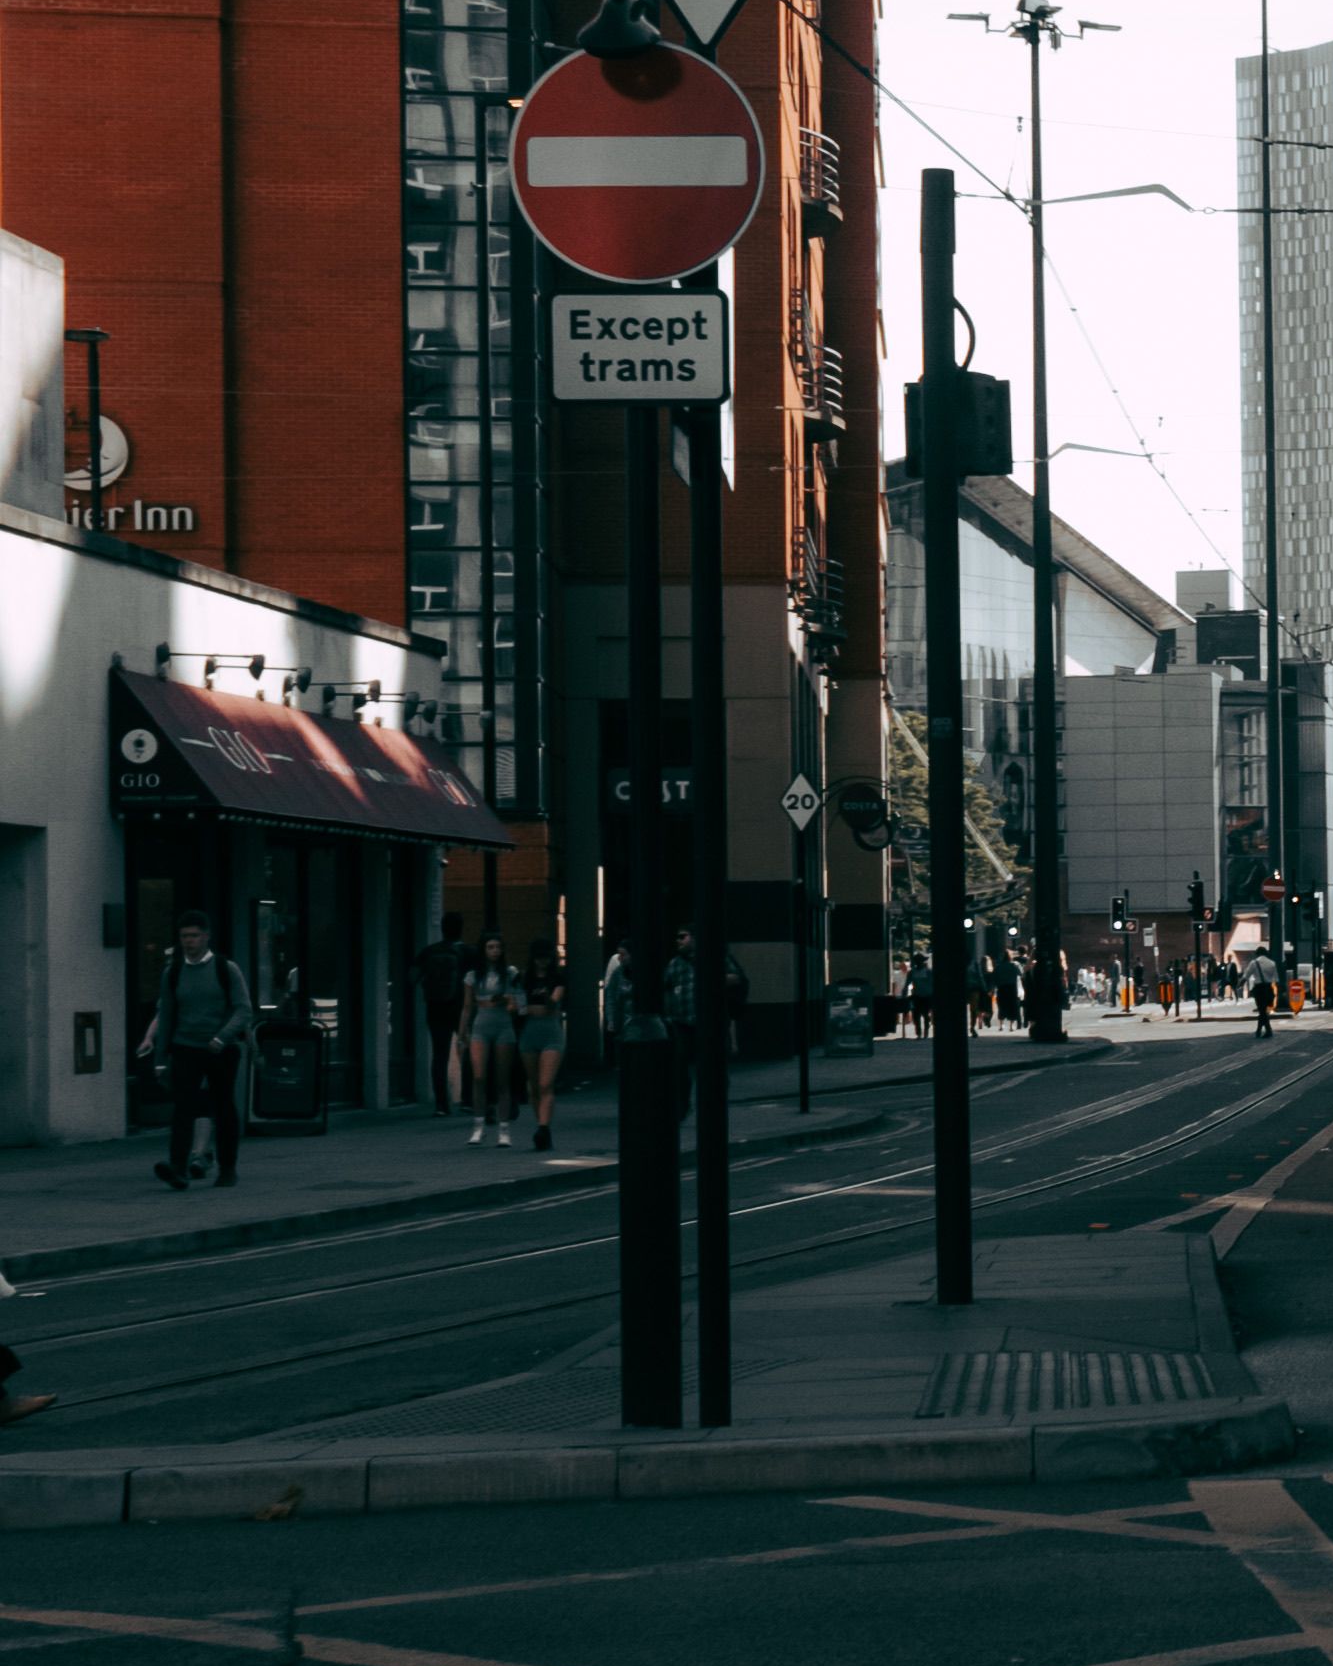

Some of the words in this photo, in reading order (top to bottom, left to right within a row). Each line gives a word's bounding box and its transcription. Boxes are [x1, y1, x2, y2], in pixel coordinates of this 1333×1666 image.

[569, 309, 708, 346] Except
[579, 351, 696, 382] trams
[133, 499, 194, 531] Inn
[207, 725, 272, 774] GIO
[120, 773, 160, 788] GIO
[786, 793, 814, 811] 20
[842, 801, 879, 811] COSTA
